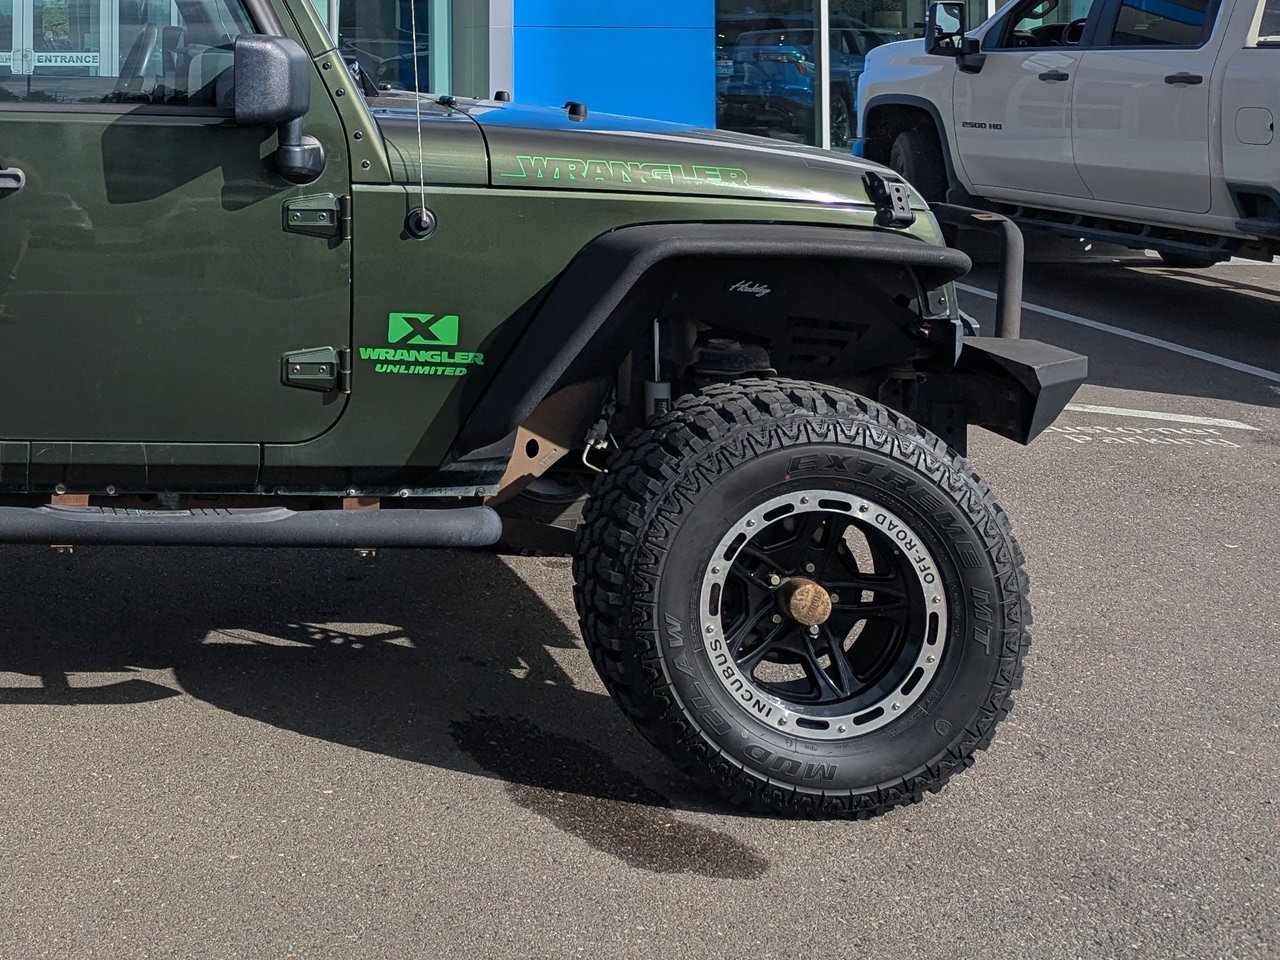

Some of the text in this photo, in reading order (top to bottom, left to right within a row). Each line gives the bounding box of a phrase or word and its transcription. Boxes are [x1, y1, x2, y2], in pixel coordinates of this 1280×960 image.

[37, 55, 99, 64] ENTRANCE
[961, 121, 987, 129] 2500
[501, 156, 751, 189] WRANGLER
[359, 347, 485, 365] WRANGLER
[374, 363, 468, 376] UNLIMITED
[1042, 425, 1223, 437] ustomer
[787, 453, 985, 569] EXTREME
[970, 586, 995, 656] MT
[874, 512, 936, 585] OFF-ROAD
[708, 638, 774, 719] INCUBUS
[743, 745, 839, 782] MUD
